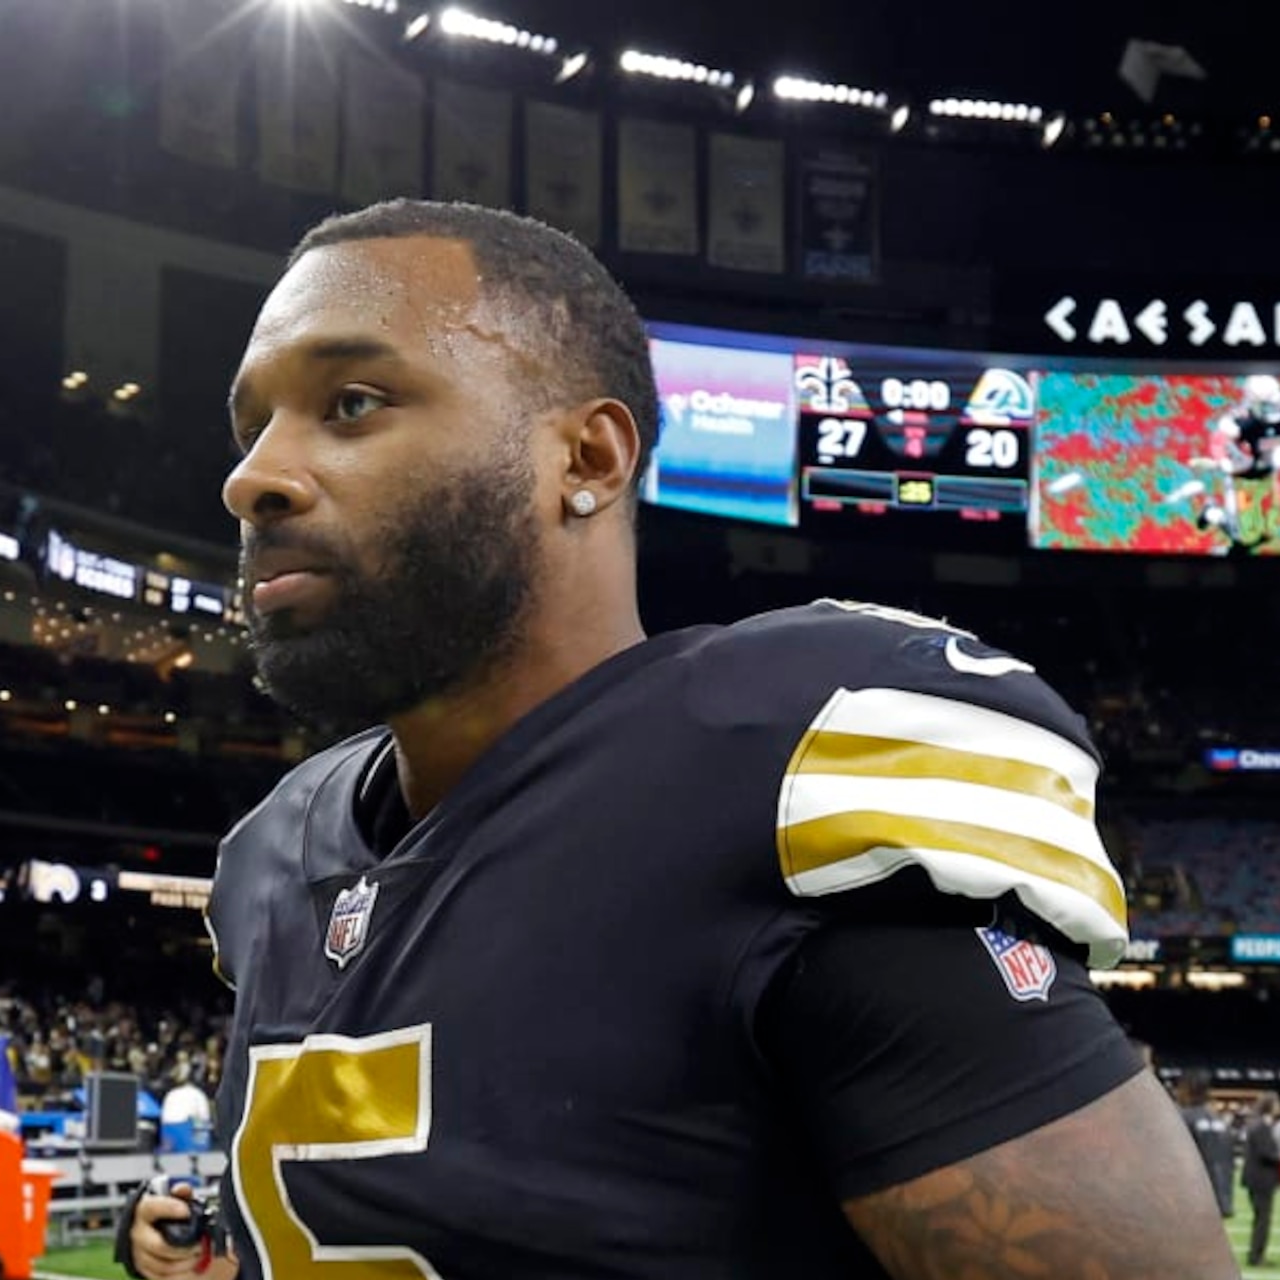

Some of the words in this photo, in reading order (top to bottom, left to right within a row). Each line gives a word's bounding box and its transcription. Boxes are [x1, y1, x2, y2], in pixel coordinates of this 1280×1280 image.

[818, 418, 867, 458] 27
[966, 429, 1018, 468] 20
[1003, 942, 1049, 990] NFL
